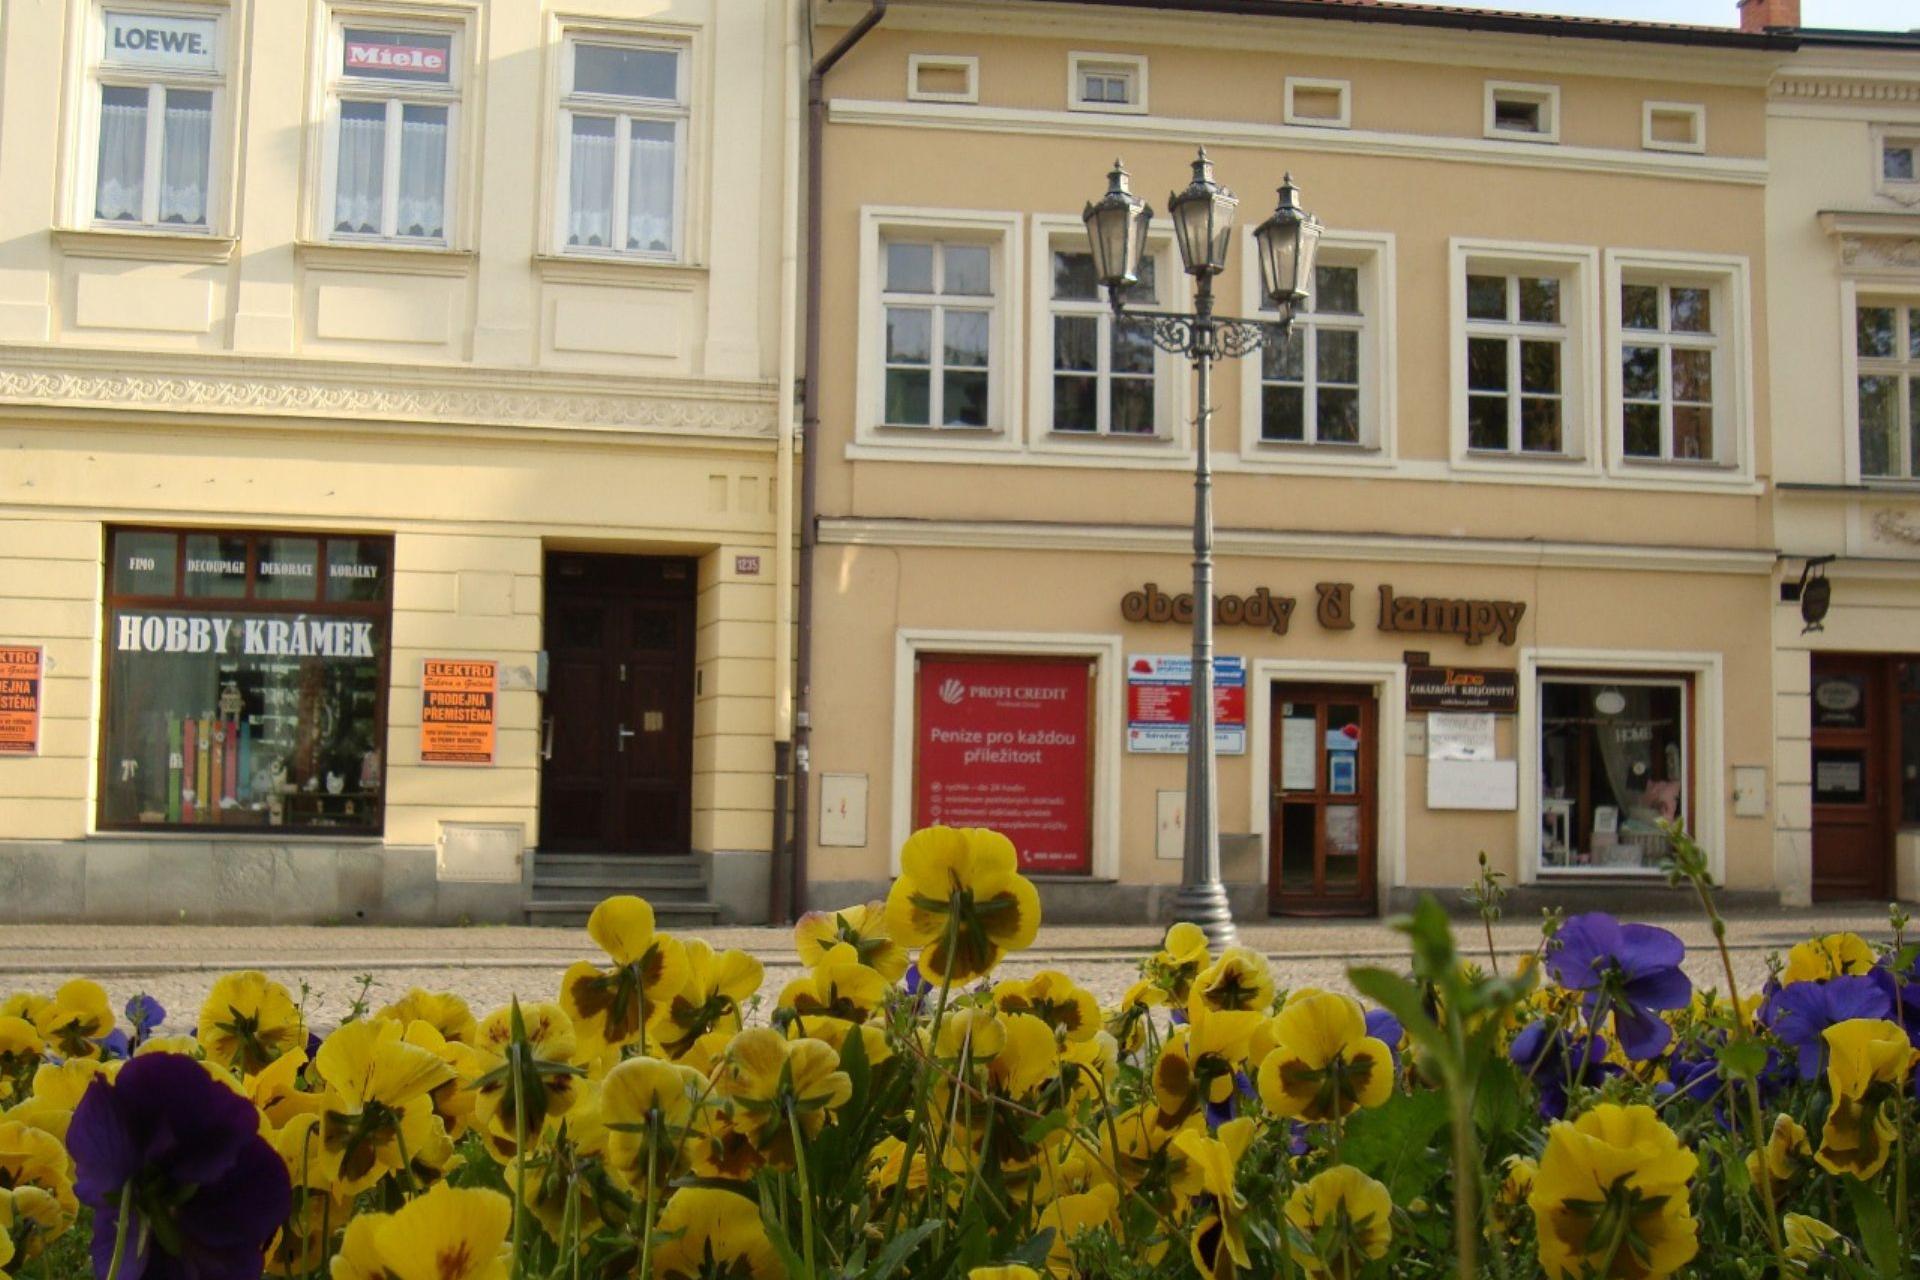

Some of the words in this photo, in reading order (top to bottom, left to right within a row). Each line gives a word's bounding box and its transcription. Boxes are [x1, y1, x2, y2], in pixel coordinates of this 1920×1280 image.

[114, 26, 207, 56] LOEWE.
[349, 45, 443, 69] Miele
[129, 557, 155, 571] FIMO
[187, 559, 245, 574] DECOUPAGE
[260, 561, 313, 576] DEKORACE
[330, 563, 378, 578] KORÁLKY
[1120, 583, 1296, 636] obcody
[1377, 584, 1527, 646] lampy
[117, 615, 233, 654] HOBBY
[243, 613, 374, 658] KRÁMEK
[427, 663, 492, 677] ELEKTRO
[430, 692, 487, 707] PRODEJNA
[969, 687, 1011, 699] PROFI
[1014, 688, 1068, 701] CREDIT
[987, 730, 1014, 747] pro
[1018, 730, 1076, 746] každou
[964, 748, 1043, 766] příležitost
